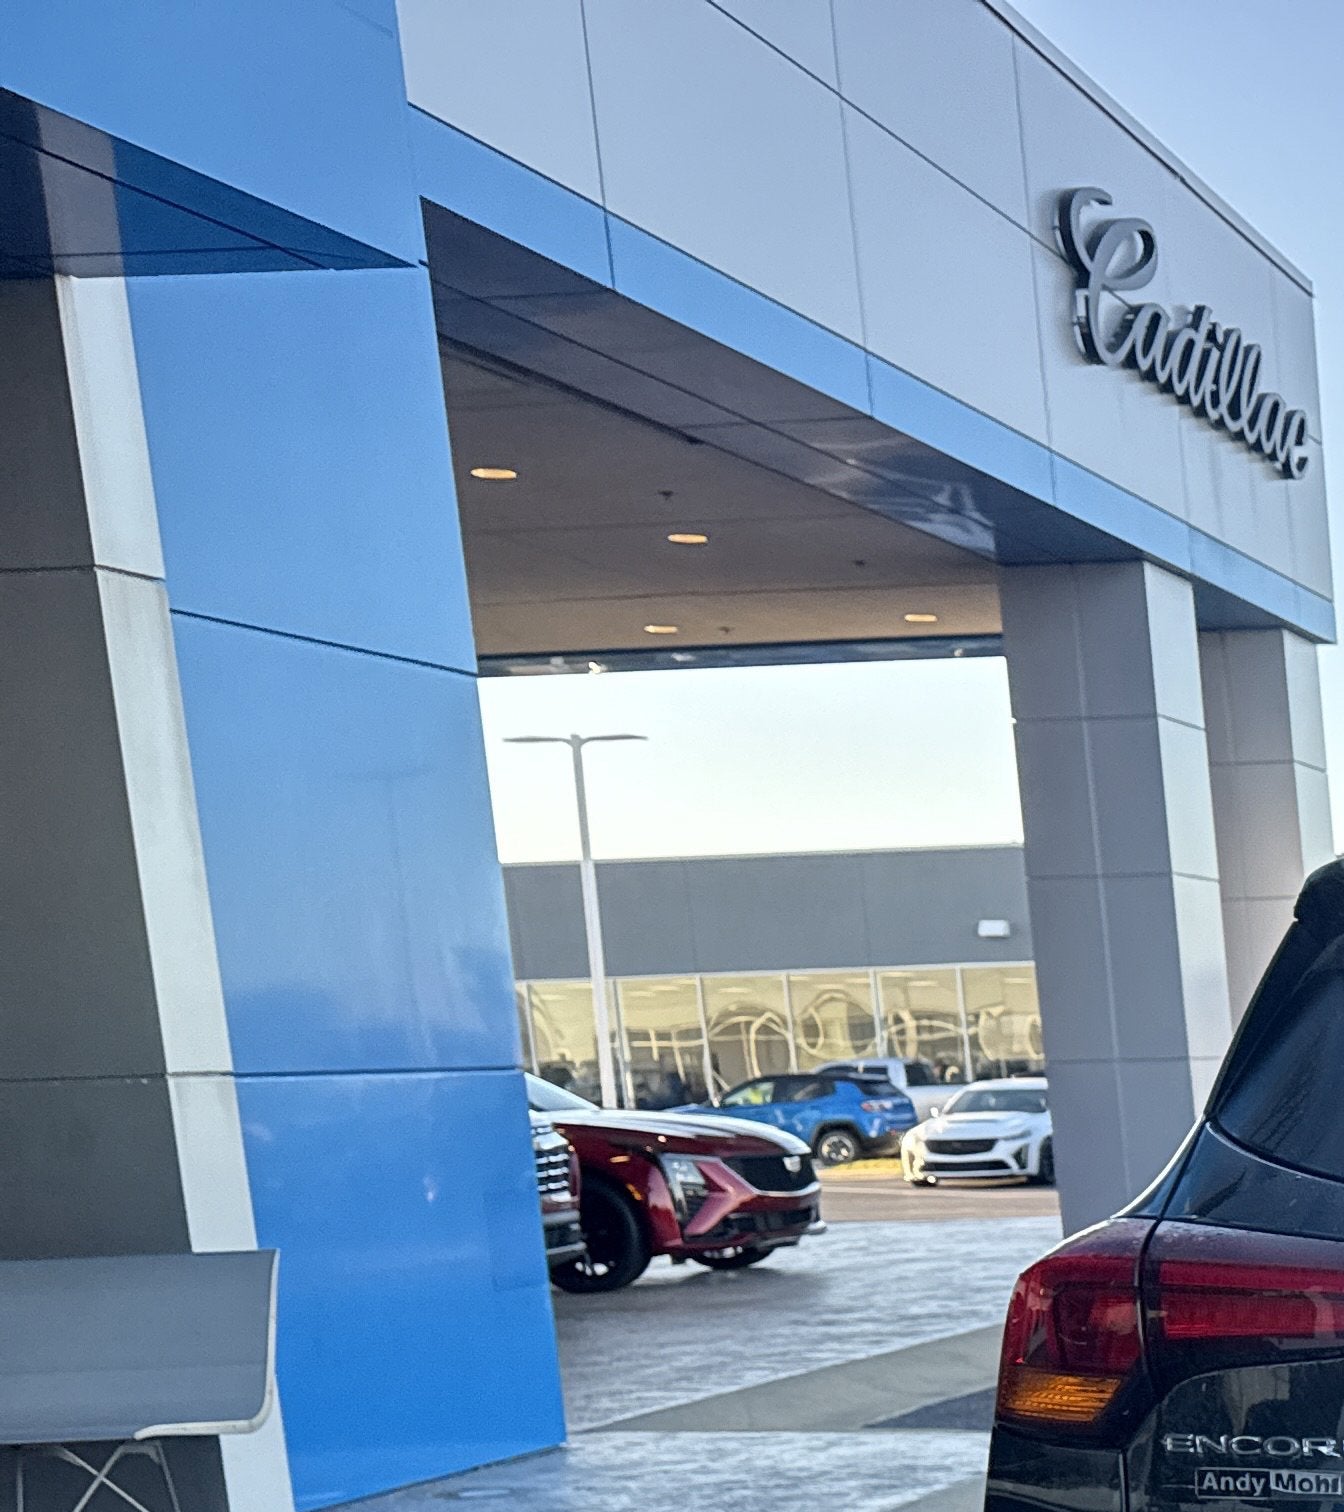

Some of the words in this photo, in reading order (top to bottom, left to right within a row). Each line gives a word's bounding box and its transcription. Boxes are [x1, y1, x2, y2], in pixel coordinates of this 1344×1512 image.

[1055, 187, 1310, 479] Cadillac
[1200, 1470, 1268, 1497] Andy
[1273, 1471, 1342, 1495] Mohr
